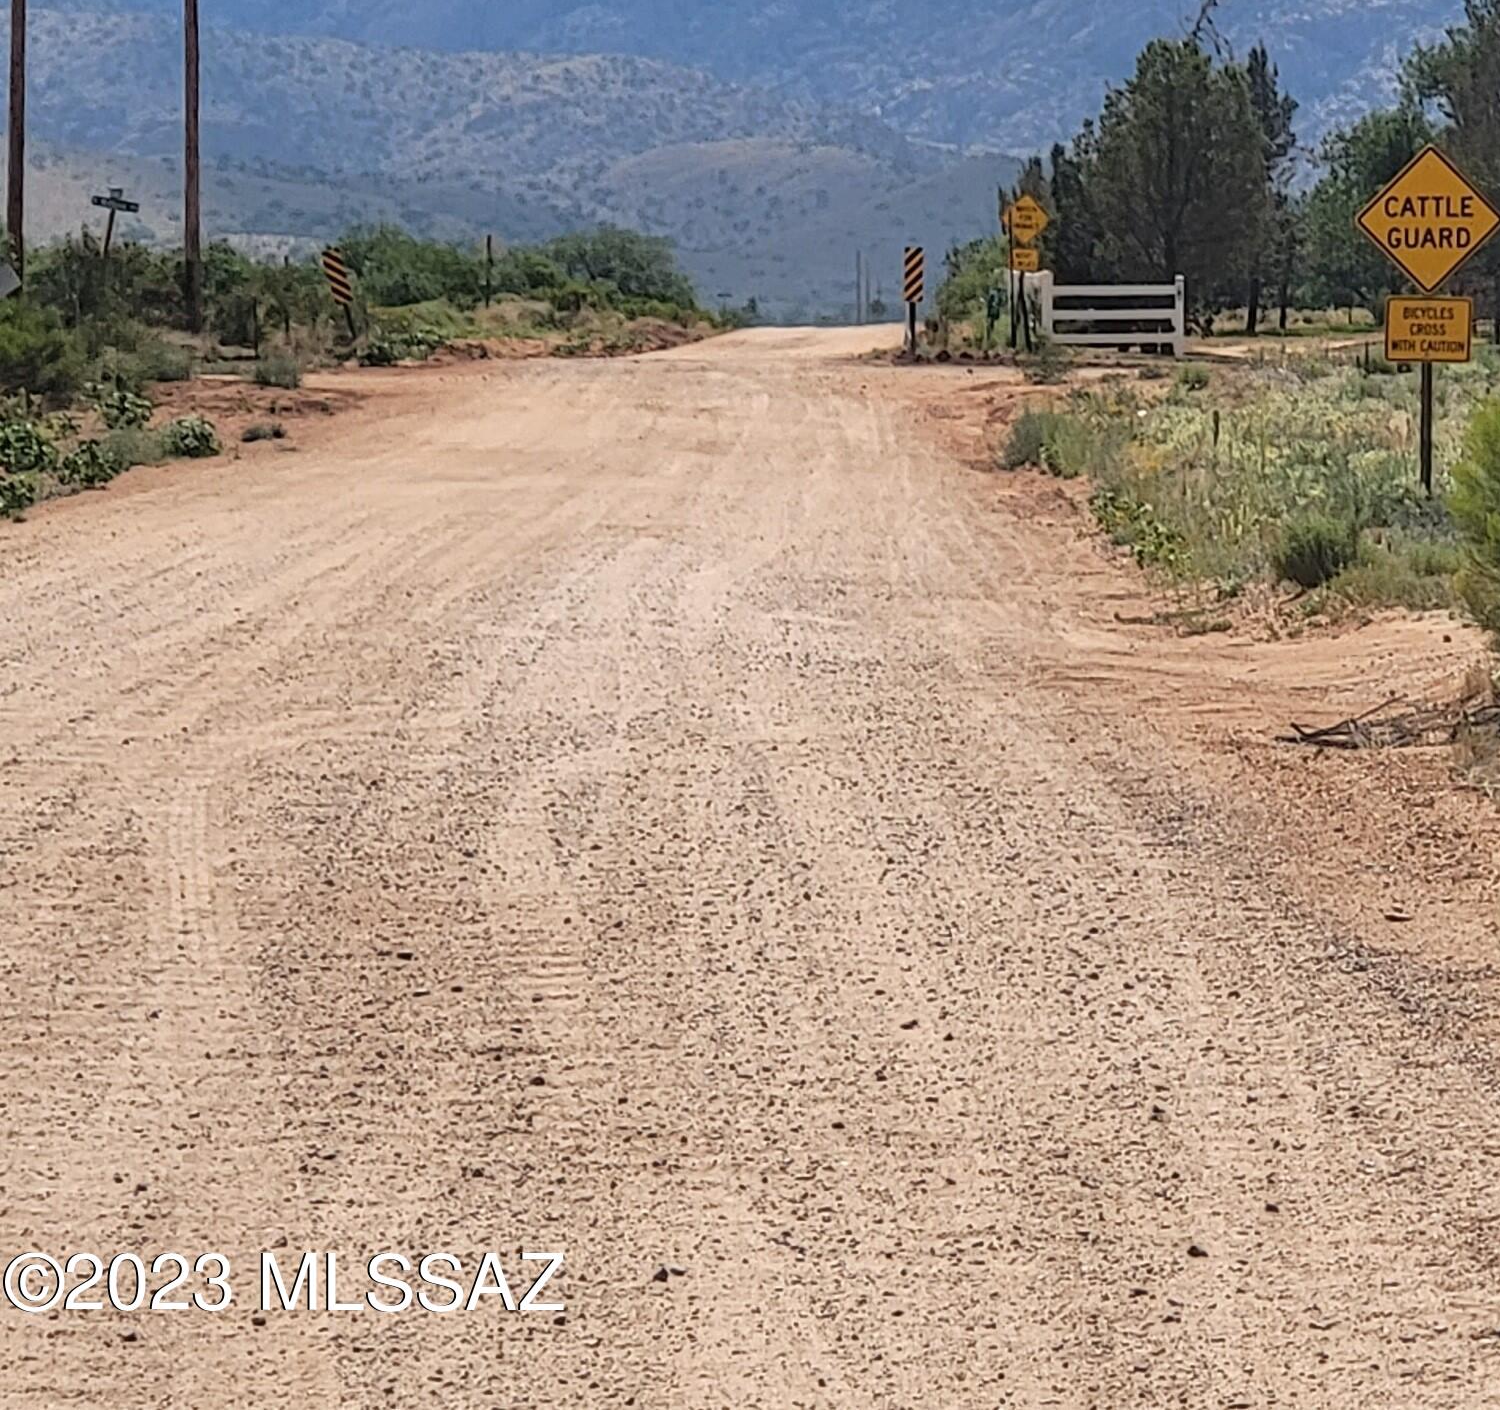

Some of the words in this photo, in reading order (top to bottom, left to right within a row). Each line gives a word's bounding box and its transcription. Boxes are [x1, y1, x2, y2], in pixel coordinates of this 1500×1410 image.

[1384, 196, 1474, 218] CATTLE
[1387, 227, 1471, 249] GUARD
[1403, 306, 1454, 320] BICYCLES
[1410, 323, 1446, 336] CROSS
[1392, 339, 1416, 352] WITH
[1420, 339, 1465, 353] CAUTION
